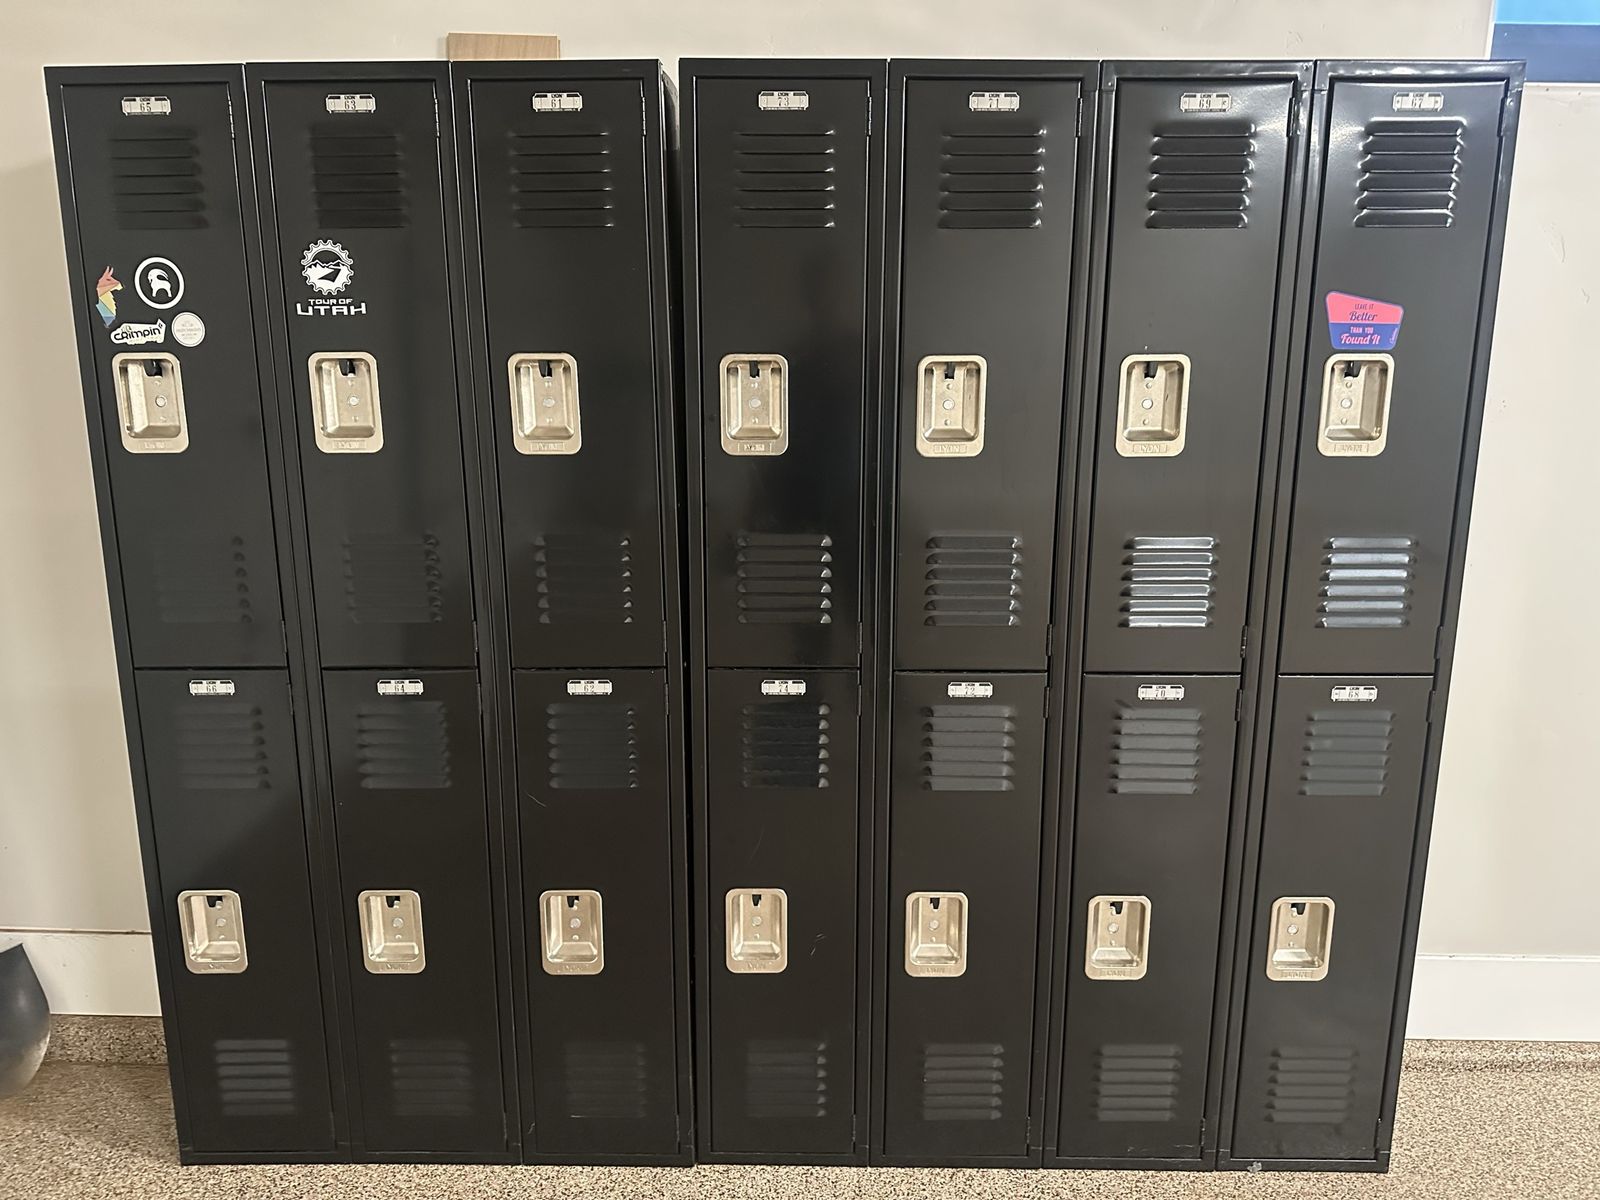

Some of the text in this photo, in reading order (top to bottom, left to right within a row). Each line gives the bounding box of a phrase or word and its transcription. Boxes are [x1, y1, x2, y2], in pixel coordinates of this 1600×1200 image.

[345, 101, 356, 110] 63
[551, 99, 561, 108] 61
[778, 97, 789, 106] 73
[989, 99, 999, 108] 71
[1199, 99, 1211, 109] 69
[1412, 99, 1423, 108] 67
[140, 103, 151, 112] 65
[296, 302, 366, 315] UTAH
[1349, 311, 1378, 321] Better
[1341, 334, 1370, 344] Found
[395, 685, 404, 693] 64
[965, 687, 975, 695] 72
